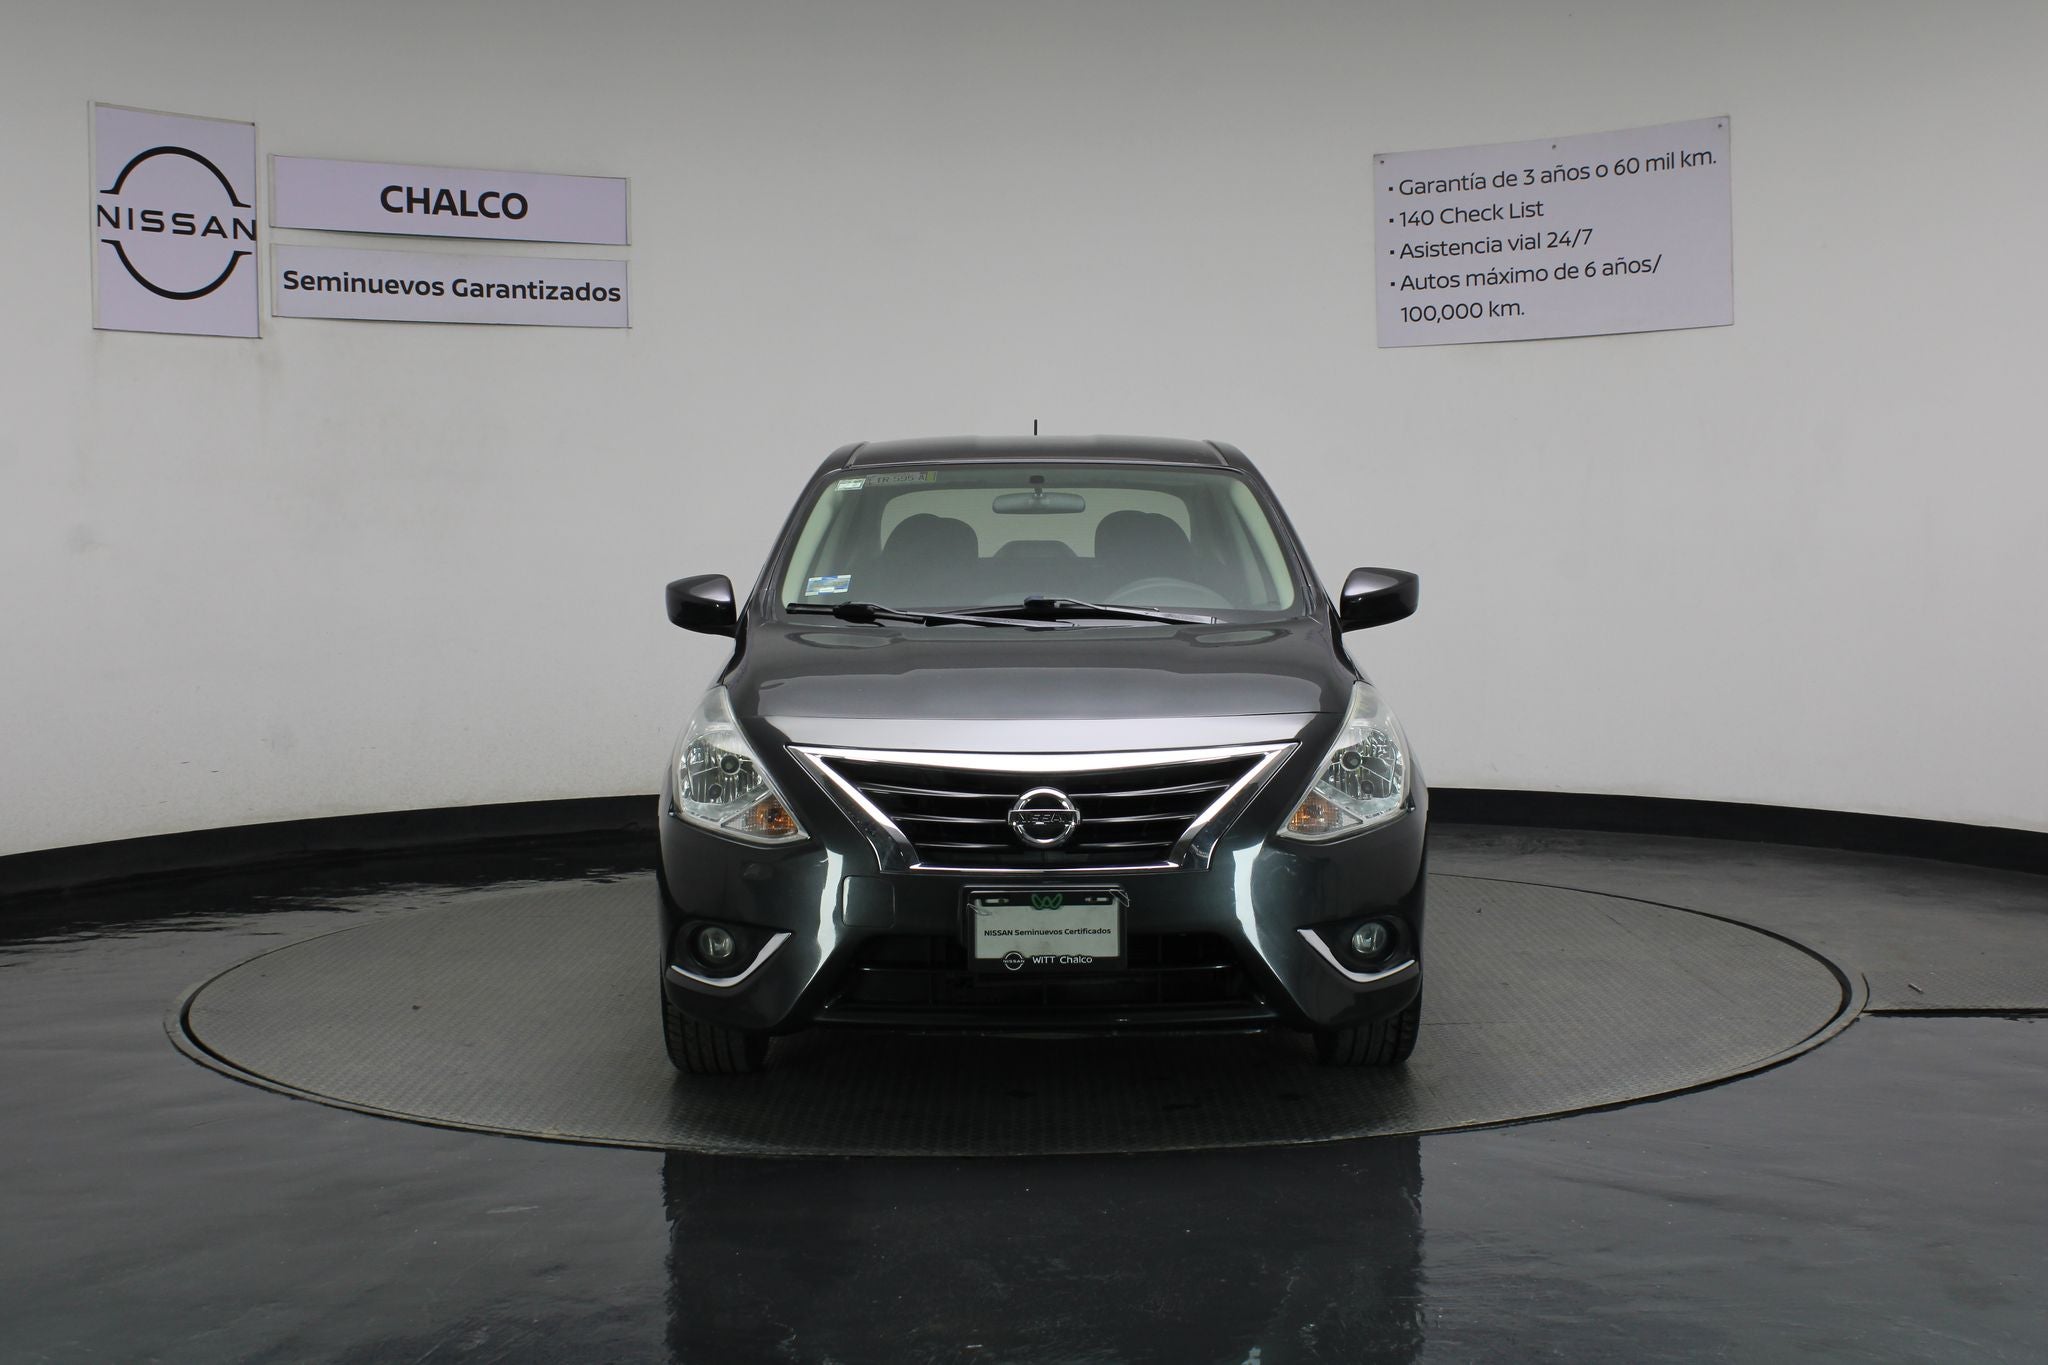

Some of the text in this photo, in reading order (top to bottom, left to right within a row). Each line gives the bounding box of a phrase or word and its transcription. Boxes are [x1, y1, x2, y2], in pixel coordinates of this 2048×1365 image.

[1399, 148, 1717, 196] Garantía de 3 años o 60 mil km.
[380, 184, 529, 220] CHALCO
[1399, 200, 1545, 228] 140 Check List
[97, 204, 257, 242] NISSAN
[1399, 228, 1593, 260] Asistencia vial 24/7
[283, 270, 622, 303] Seminuevos Garantizados
[1400, 254, 1663, 292] Autos máximo de 6 años/
[1401, 300, 1526, 324] 100,000 km.
[983, 927, 1111, 937] NISSAN Seminuevos Certificados
[1032, 955, 1093, 964] WITT Chalco
